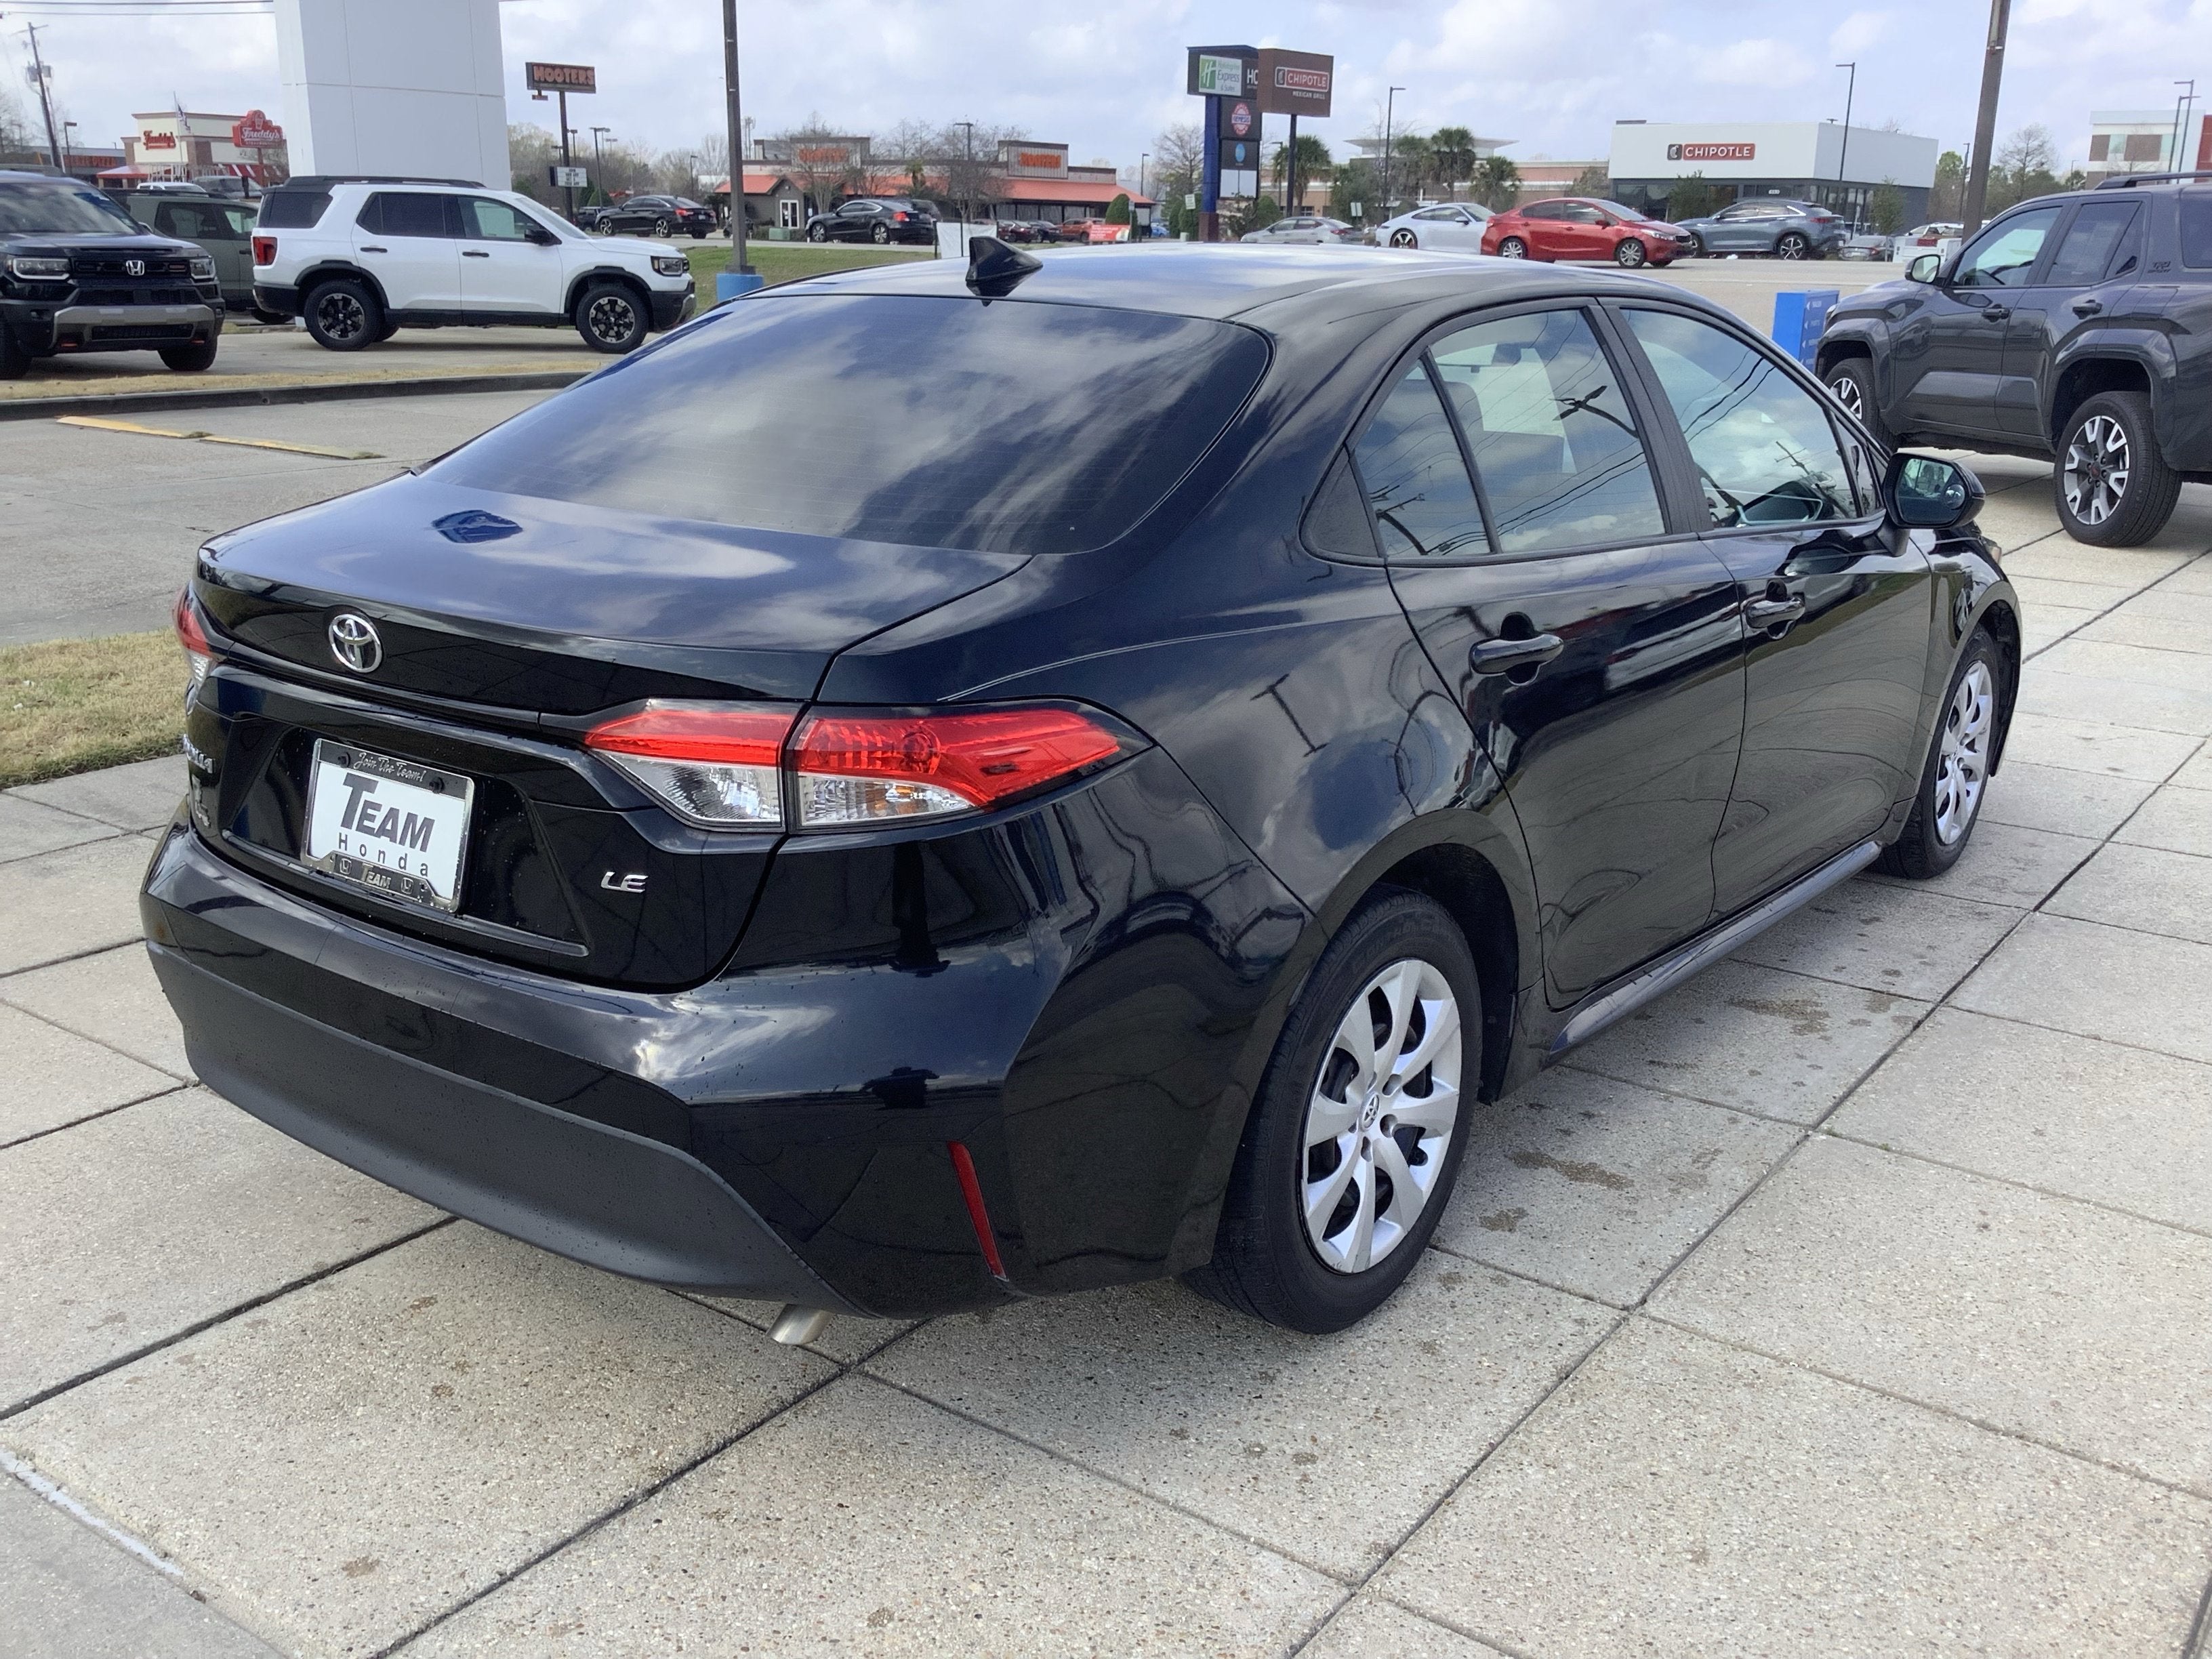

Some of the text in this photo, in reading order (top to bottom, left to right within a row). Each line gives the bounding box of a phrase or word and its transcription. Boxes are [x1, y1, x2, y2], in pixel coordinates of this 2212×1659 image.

[533, 66, 594, 85] HOOTERS
[1217, 70, 1240, 83] Express
[1288, 73, 1327, 87] CHIPOTLE
[241, 127, 280, 142] Freddy's
[1685, 146, 1751, 157] CHIPOTLE
[353, 752, 377, 770] Join
[378, 757, 395, 773] The
[340, 772, 435, 853] TEAM
[338, 832, 429, 877] Honda
[361, 863, 392, 889] TEAM
[600, 871, 649, 893] LE
